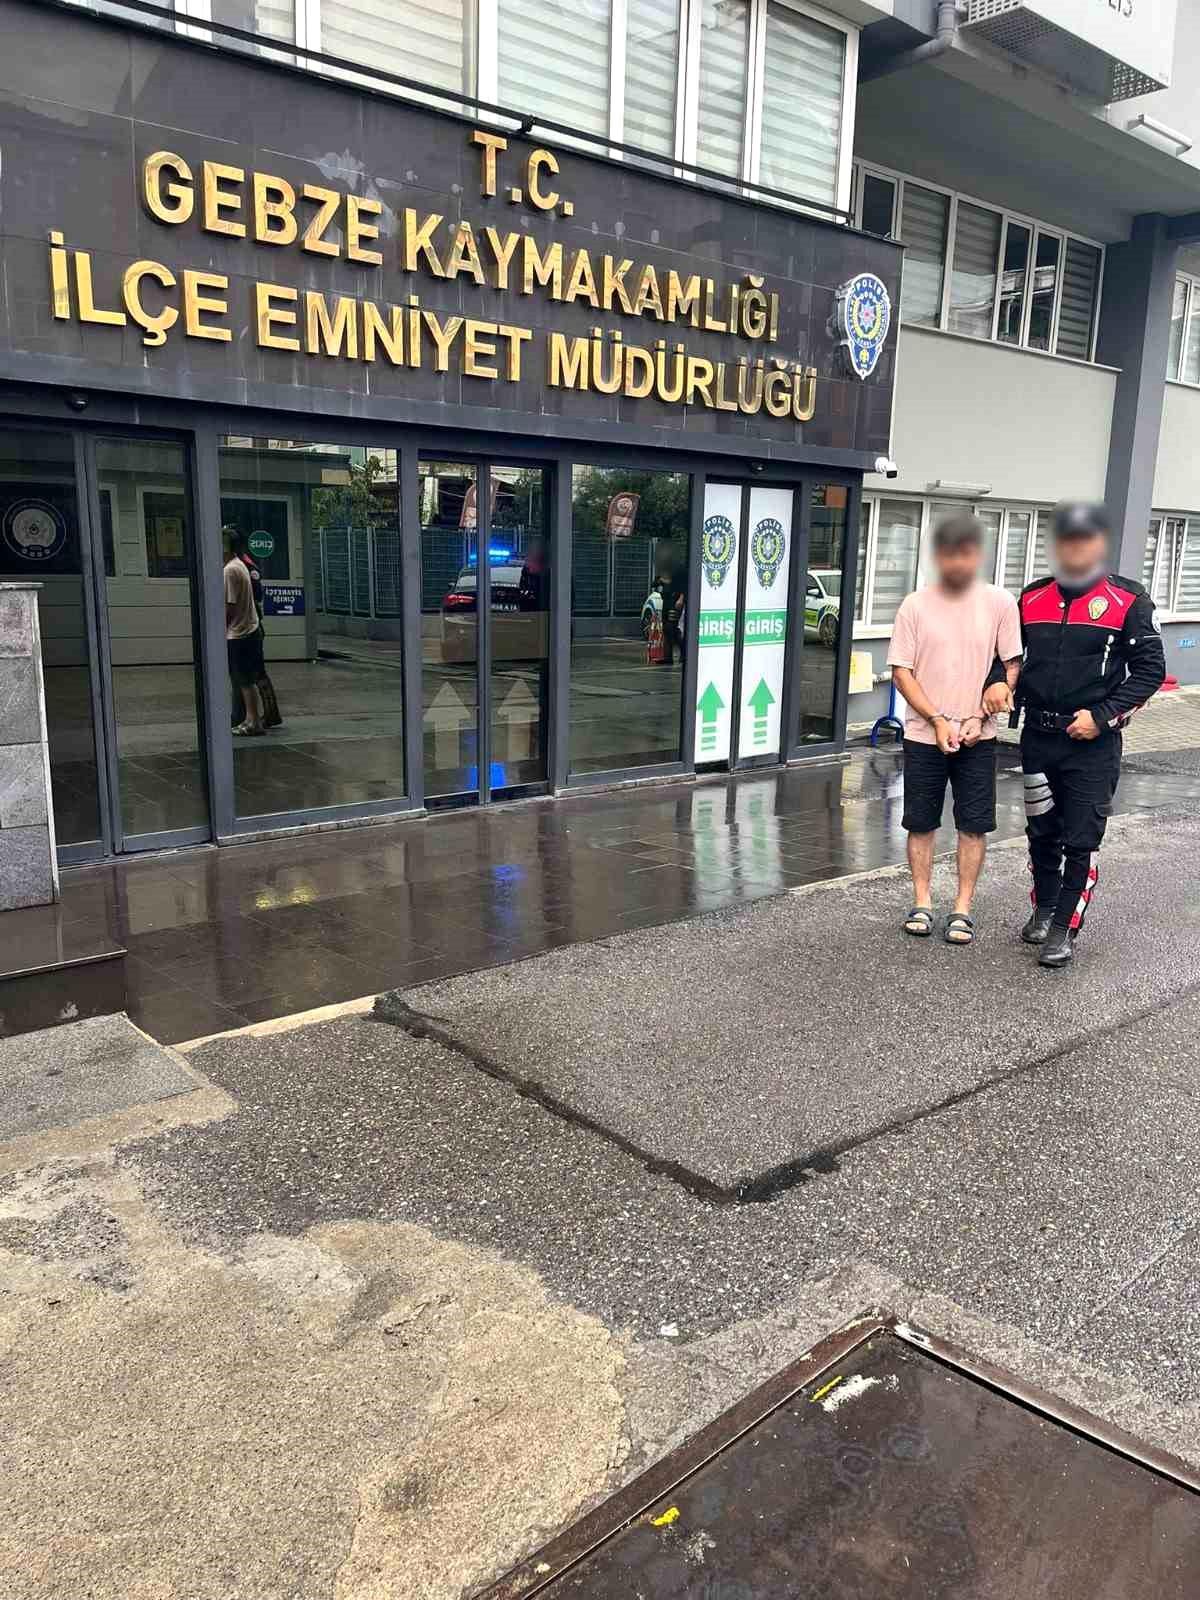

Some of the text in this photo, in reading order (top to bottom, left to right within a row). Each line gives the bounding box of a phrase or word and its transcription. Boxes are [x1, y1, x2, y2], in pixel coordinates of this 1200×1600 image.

[471, 130, 574, 216] T.C.
[143, 150, 383, 265] GEBZE
[402, 208, 779, 342] KAYMAKAMLIĞI
[49, 231, 818, 422] İLÇE EMNİYET MÜDÜRLÜĞÜ
[745, 615, 784, 638] GİRİŞ
